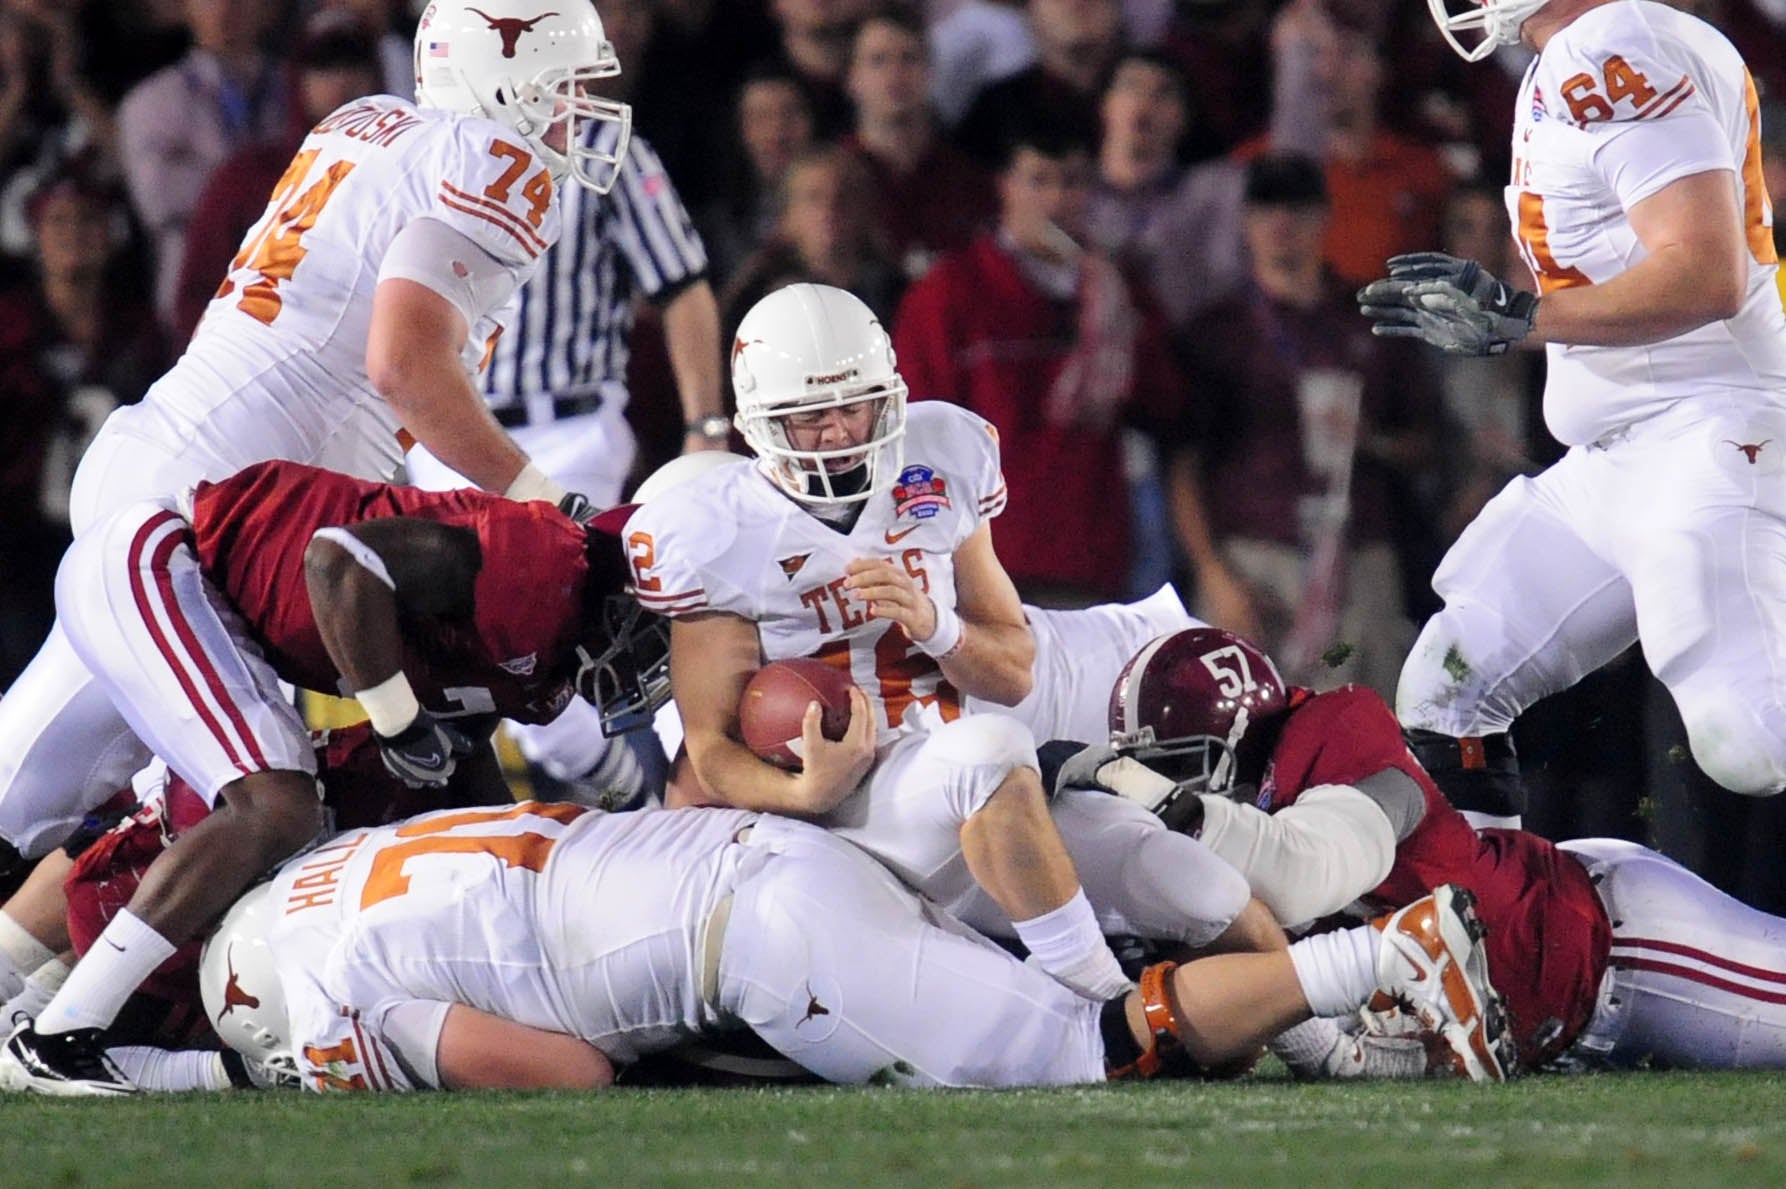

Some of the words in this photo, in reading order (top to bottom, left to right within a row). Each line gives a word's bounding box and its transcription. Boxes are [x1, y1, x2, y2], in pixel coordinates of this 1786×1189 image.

[1560, 54, 1657, 122] 64
[484, 138, 553, 228] 74
[800, 548, 930, 634] TES
[1200, 645, 1257, 699] 57
[286, 832, 368, 916] HALL
